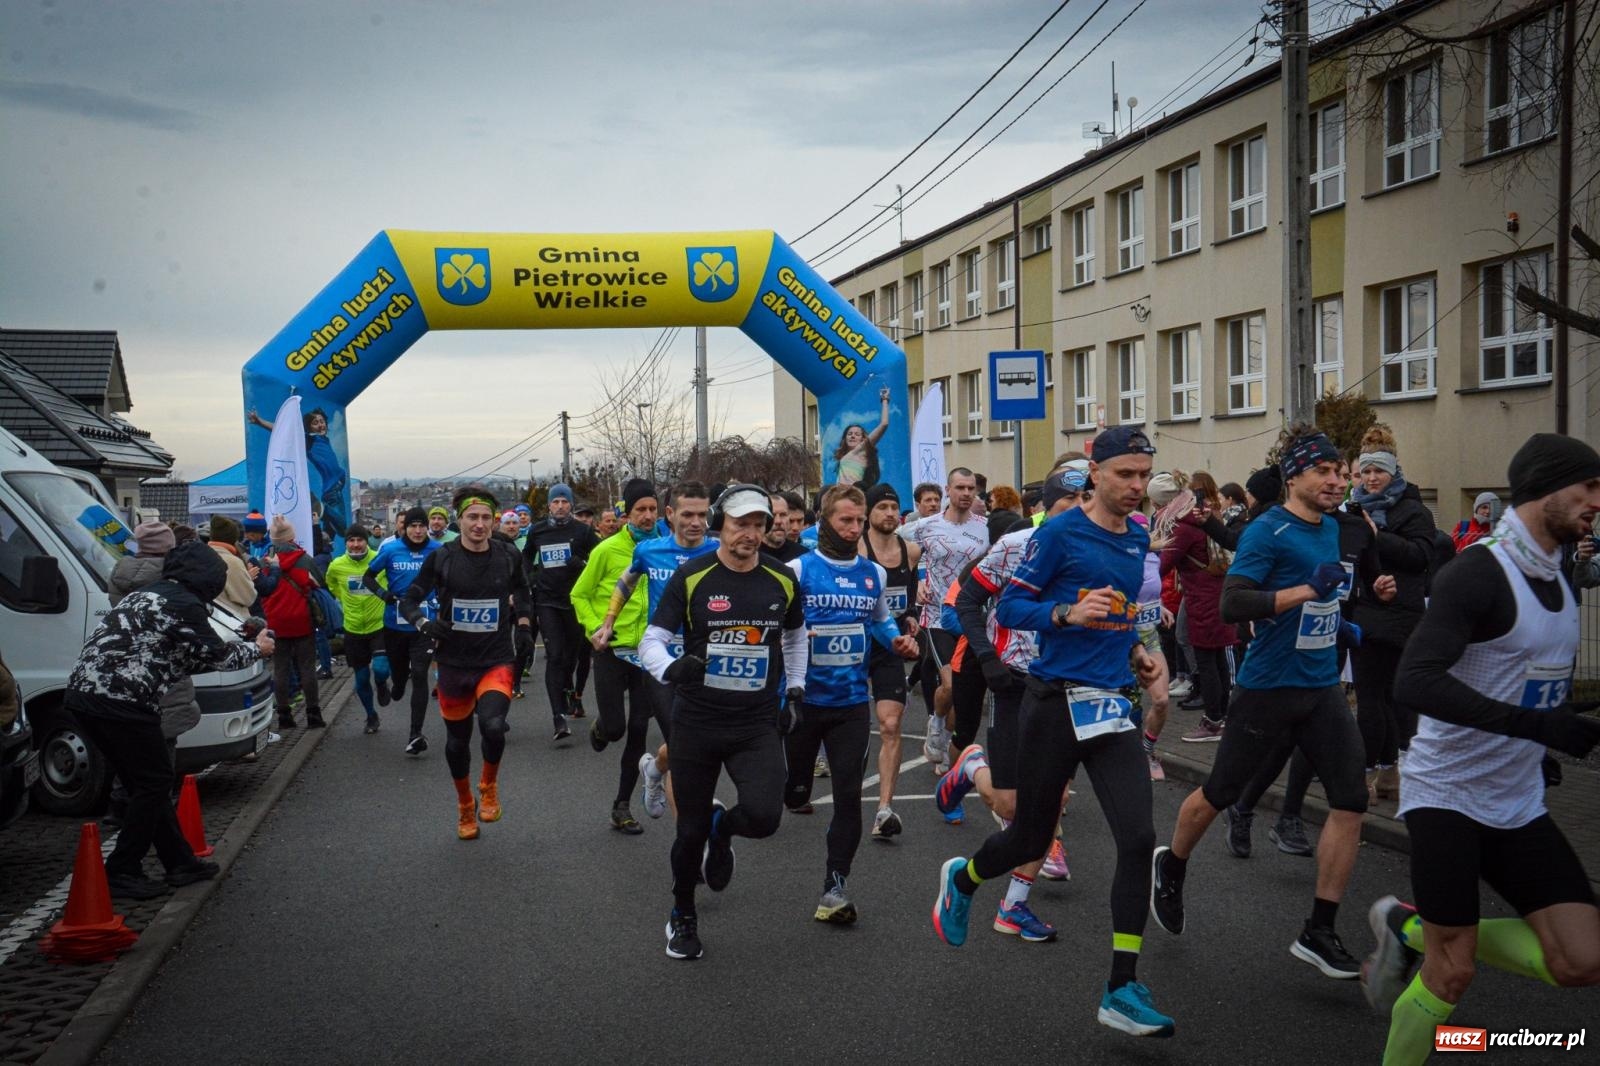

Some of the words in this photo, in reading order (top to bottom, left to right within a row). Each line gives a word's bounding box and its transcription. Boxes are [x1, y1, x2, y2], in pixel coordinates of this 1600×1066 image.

[539, 247, 639, 263] Gmina
[513, 266, 668, 286] Pietrowice
[533, 290, 647, 309] Wielkie
[285, 313, 348, 371] Gmina
[342, 267, 396, 319] ludzi
[777, 266, 831, 322] Gmina
[830, 313, 879, 363] ludzi
[312, 292, 413, 390] aktywnych
[761, 290, 858, 379] aktywnych
[545, 550, 566, 561] 188
[461, 608, 491, 622] 176
[1137, 608, 1157, 624] 153
[1310, 613, 1337, 635] 218
[828, 635, 852, 653] 60
[718, 656, 757, 677] 155
[1090, 698, 1122, 722] 74
